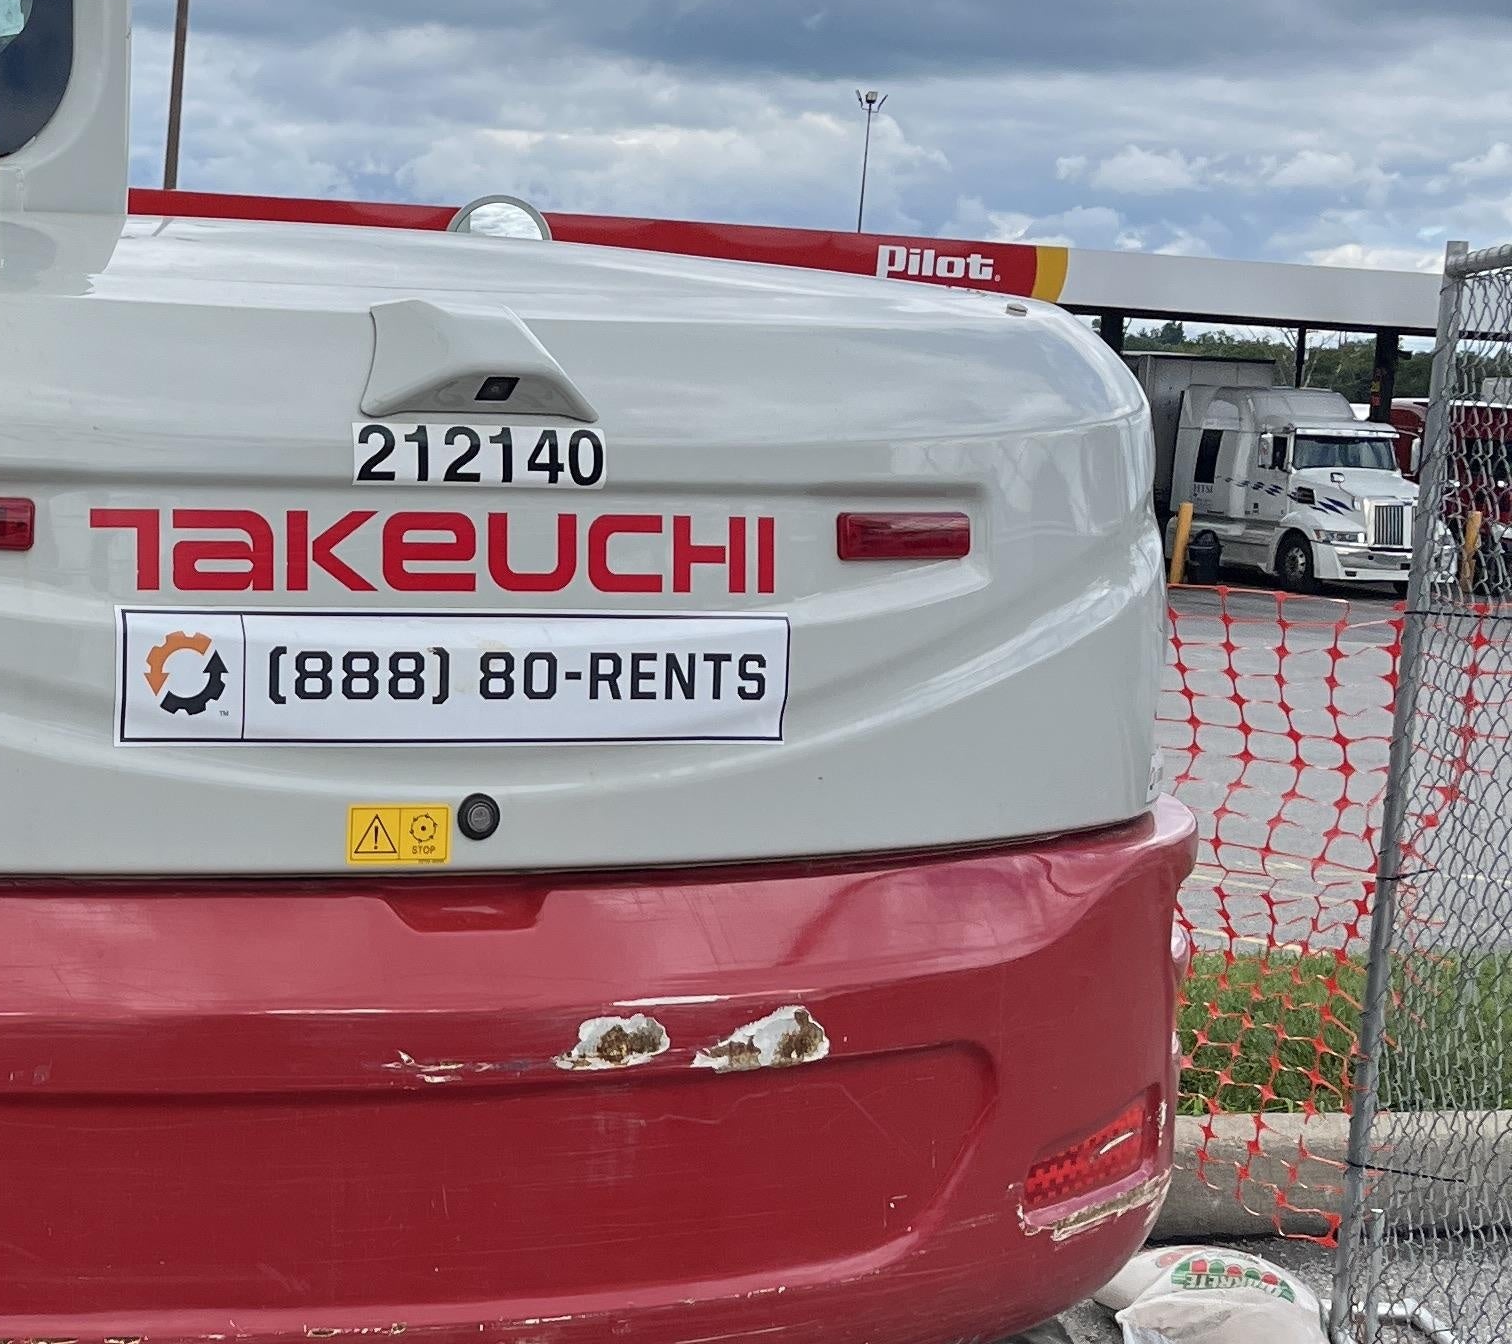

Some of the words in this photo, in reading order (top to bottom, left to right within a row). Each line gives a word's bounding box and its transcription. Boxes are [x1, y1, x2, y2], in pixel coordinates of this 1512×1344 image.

[876, 244, 994, 280] Pilot
[357, 424, 605, 487] 212140
[268, 646, 447, 705] (888)
[479, 650, 767, 702] 80-RENTS
[411, 845, 437, 855] STOP
